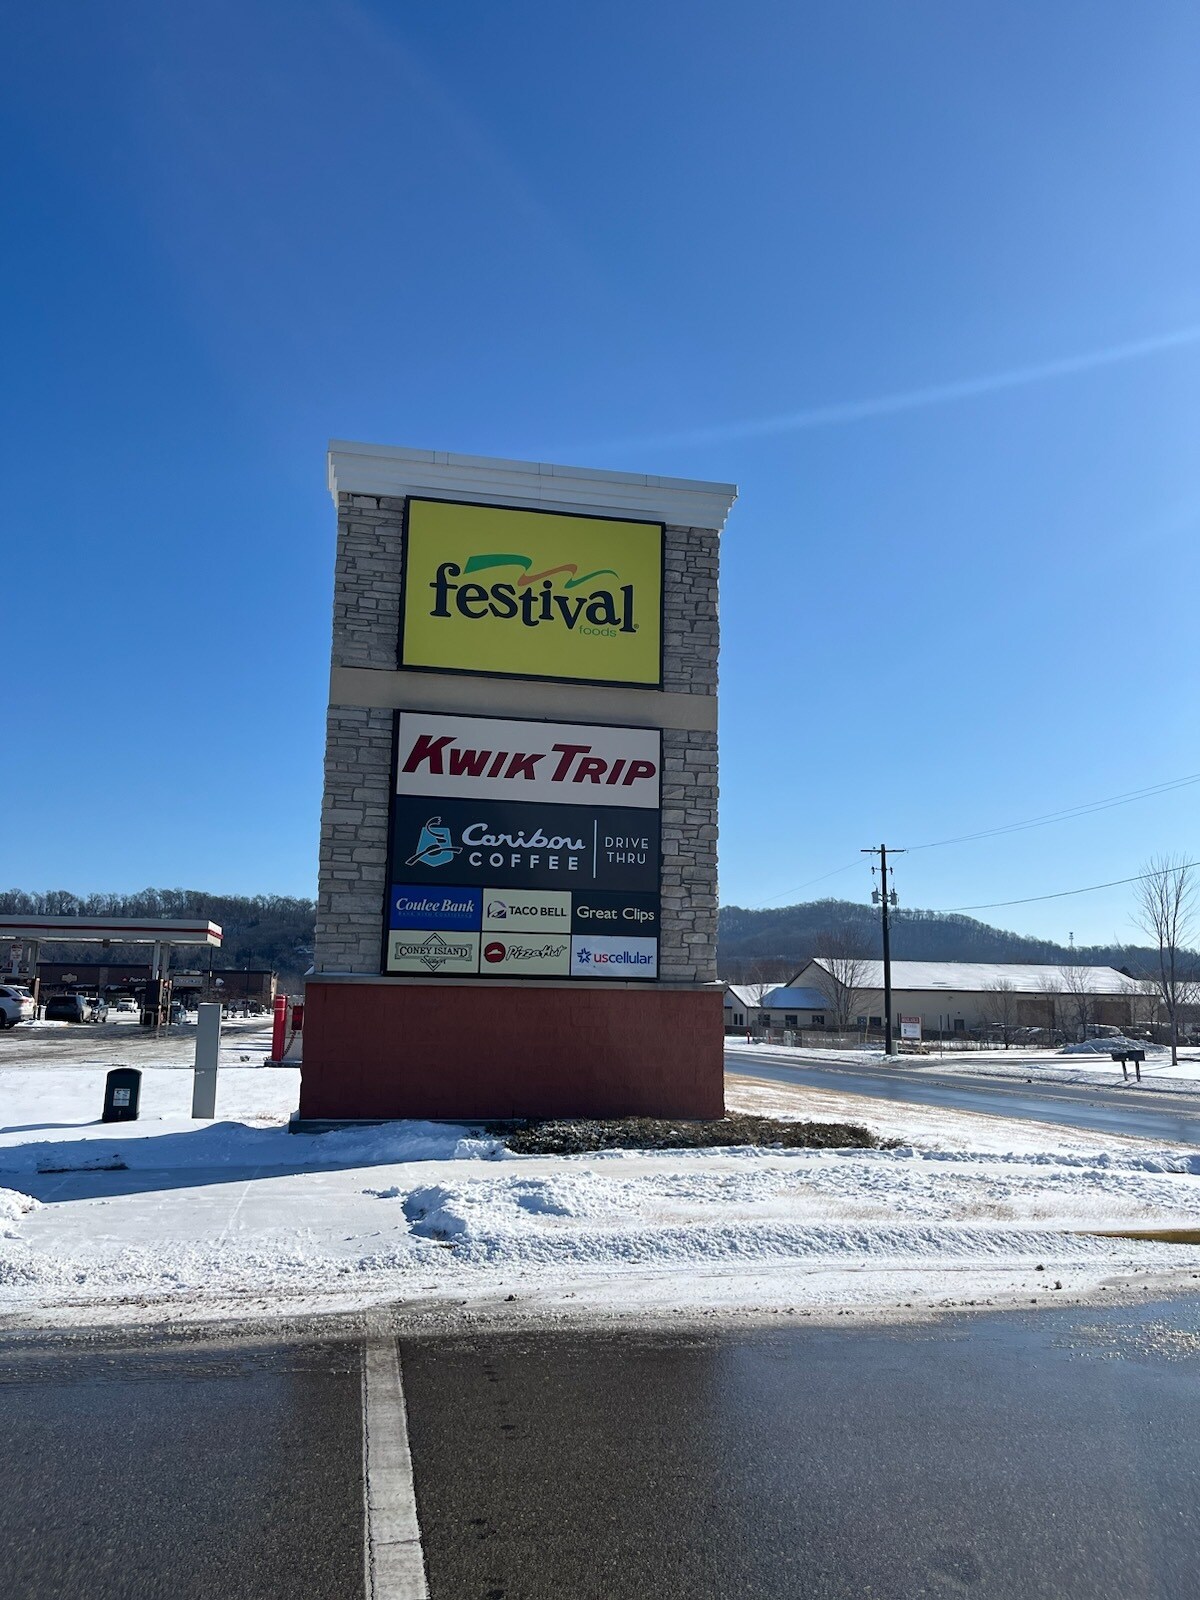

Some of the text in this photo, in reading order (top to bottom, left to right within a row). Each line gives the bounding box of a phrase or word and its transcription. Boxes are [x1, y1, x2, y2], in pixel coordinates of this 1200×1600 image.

[429, 562, 637, 633] festival
[579, 625, 617, 638] foods
[401, 734, 657, 786] KWIK TRIP
[461, 822, 586, 851] Caribou
[605, 836, 649, 850] DRIVE
[468, 852, 579, 871] COFFEE
[606, 851, 647, 865] THRU
[396, 898, 475, 913] Coulee Bank
[508, 905, 567, 917] TACO BELL
[576, 905, 655, 924] Great Clips
[399, 946, 468, 958] CONEY ISLAND
[594, 951, 653, 965] uscellular
